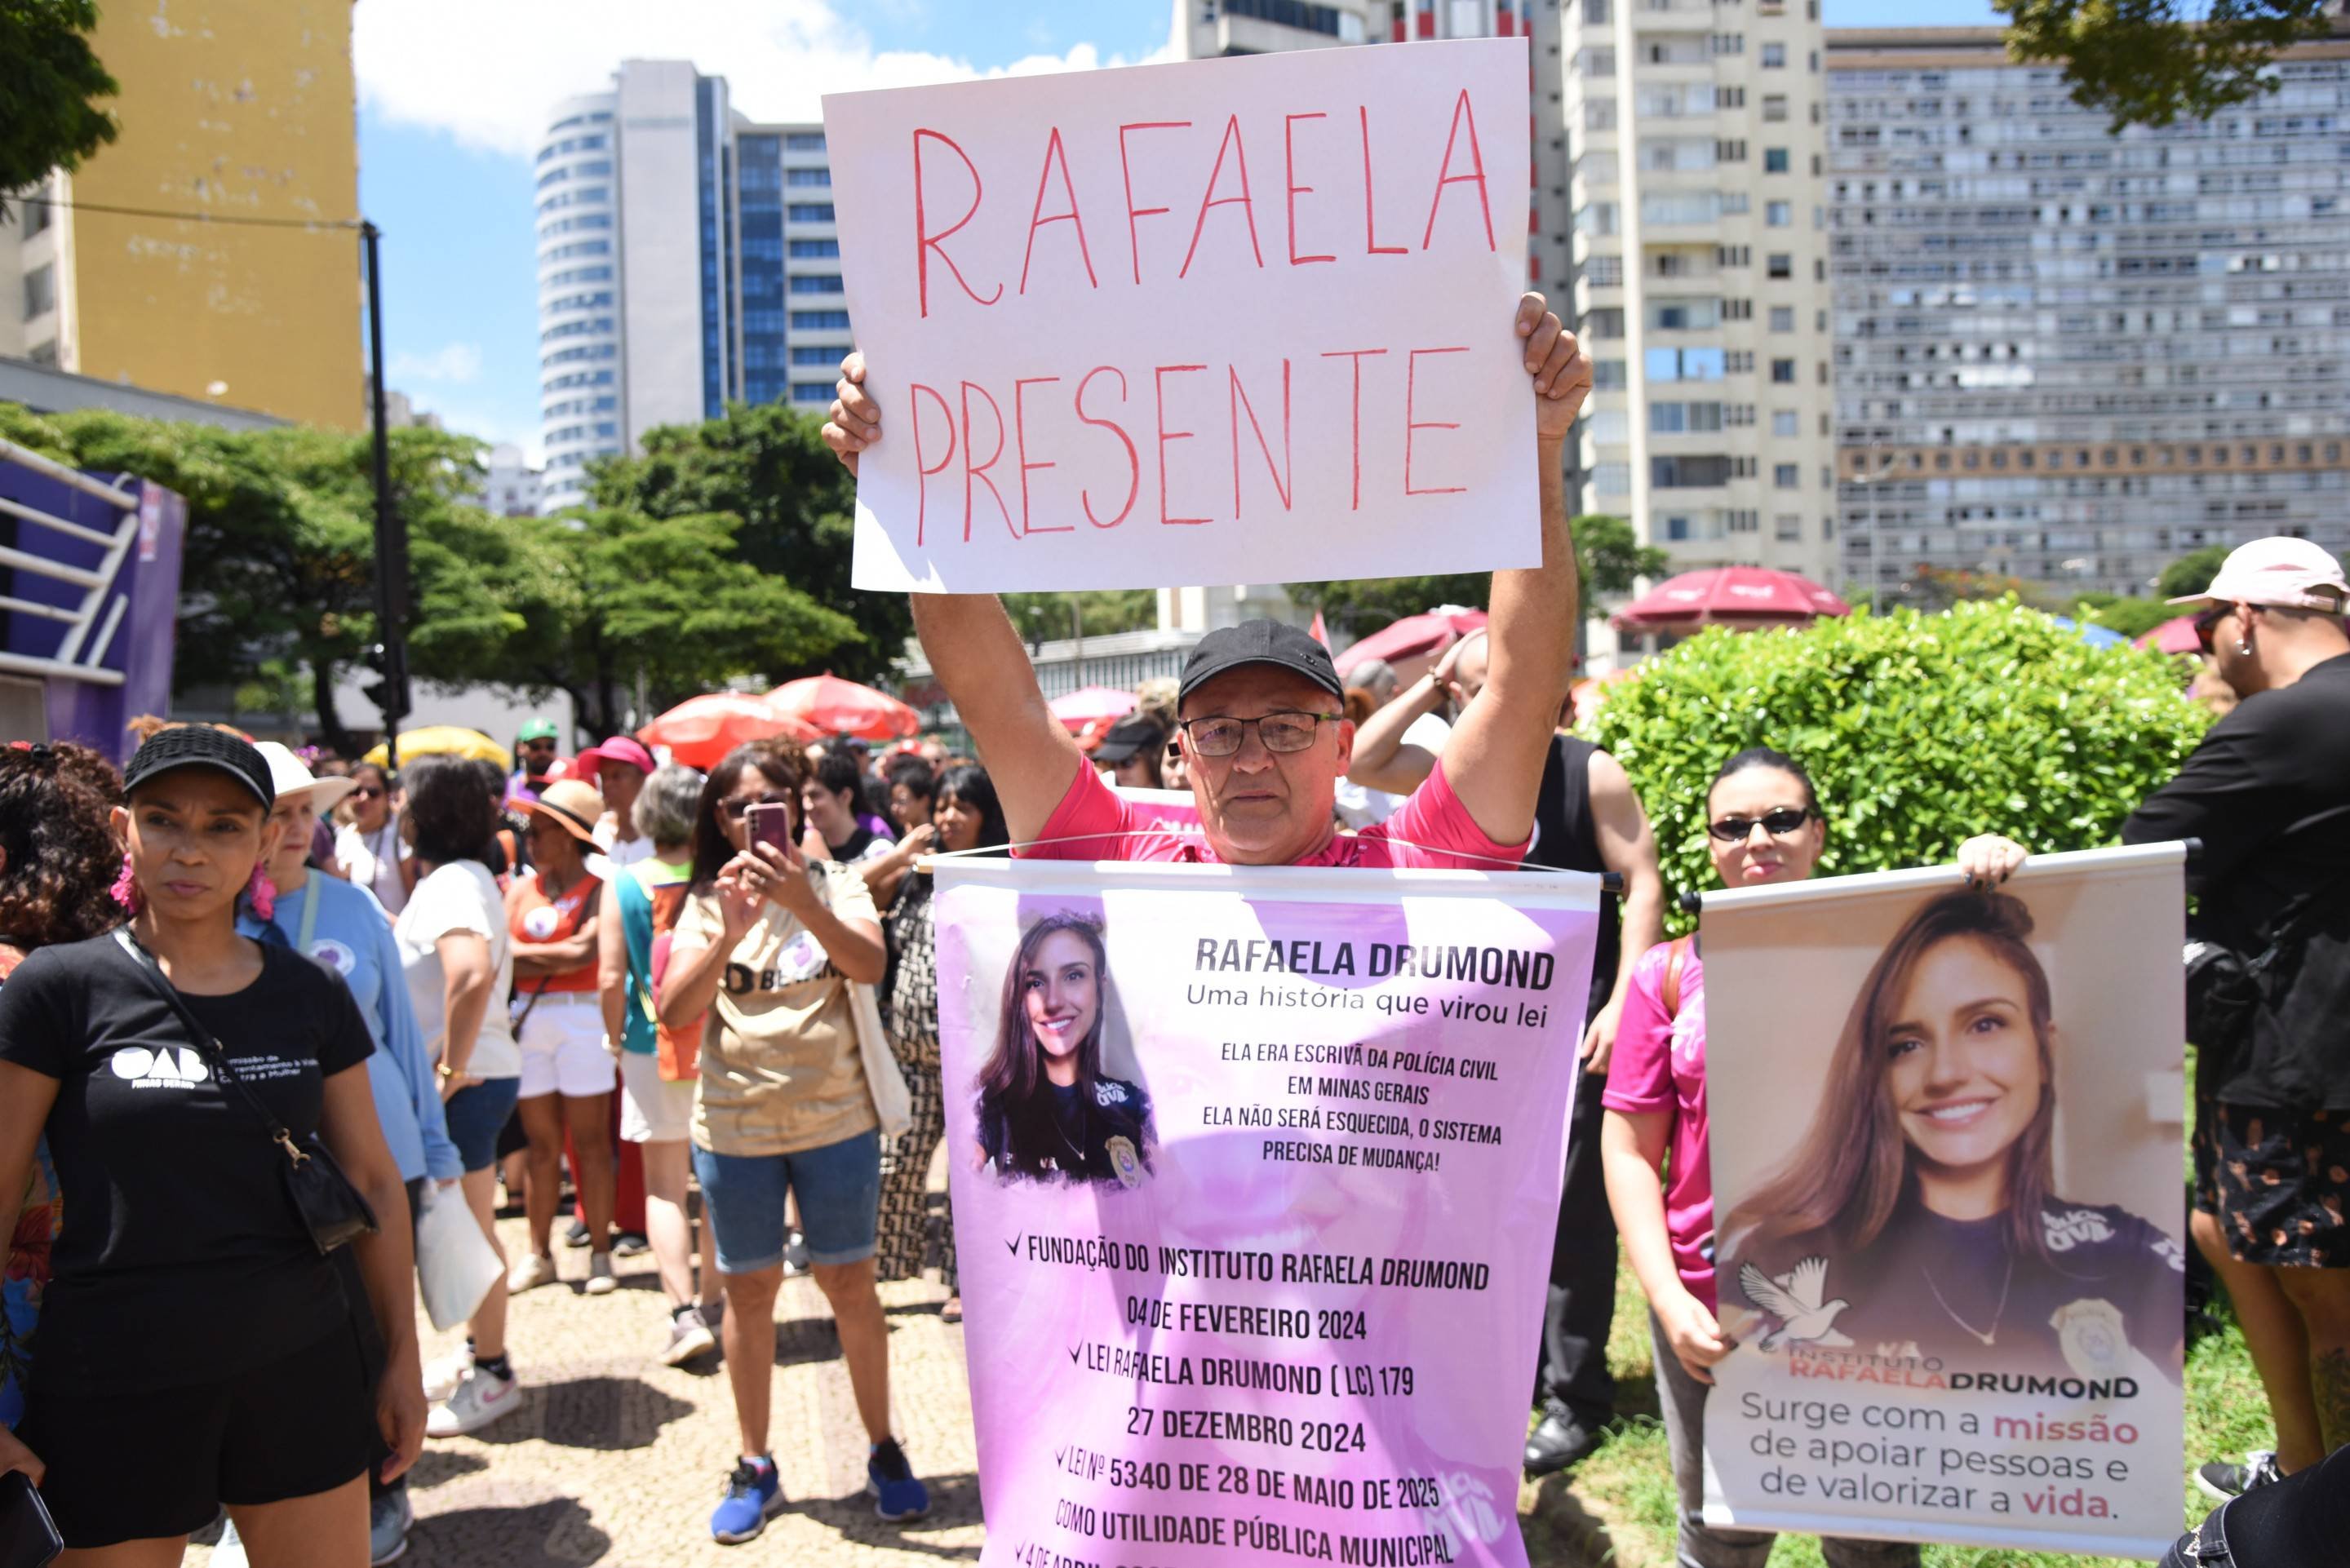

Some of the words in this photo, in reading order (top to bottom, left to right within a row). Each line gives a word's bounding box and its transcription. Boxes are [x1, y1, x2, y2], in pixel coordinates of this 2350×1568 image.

[913, 88, 1496, 318] RAFAELA
[911, 346, 1470, 547] PRESENTE
[1195, 937, 1356, 977] RAFAELA
[1368, 943, 1555, 991] DRUMOND
[1186, 984, 1248, 1006] Uma
[1259, 986, 1365, 1009] história
[1376, 993, 1430, 1014] que
[1440, 995, 1507, 1025] virou
[1518, 1003, 1548, 1028] lei
[111, 1047, 209, 1083] OAB
[1222, 1043, 1252, 1061] ELA
[1257, 1043, 1288, 1061] ERA
[1294, 1043, 1363, 1066] ESCRIVÃ
[1368, 1048, 1388, 1069] DA
[1392, 1051, 1455, 1077] POLÍCIA
[1459, 1059, 1499, 1081] CIVIL
[1288, 1076, 1313, 1095] EM
[1318, 1077, 1370, 1100] MINAS
[1375, 1082, 1430, 1105] GERAIS
[1203, 1106, 1233, 1125] ELA
[1239, 1104, 1272, 1127] NÃO
[1278, 1105, 1321, 1129] SERÁ
[1327, 1111, 1414, 1140] ESQUECIDA,
[1419, 1118, 1429, 1137] O
[1433, 1120, 1501, 1145] SISTEMA
[1263, 1141, 1333, 1164] PRECISA
[1338, 1145, 1359, 1165] DE
[1362, 1147, 1440, 1174] MUDANÇA!
[1028, 1235, 1120, 1271] FUNDAÇÃO
[1125, 1243, 1149, 1272] DO
[1159, 1247, 1273, 1282] INSTITUTO
[1281, 1253, 1373, 1285] RAFAELA
[1380, 1258, 1489, 1290] DRUMOND
[1128, 1296, 1147, 1326] 04
[1150, 1299, 1173, 1330] DE
[1180, 1304, 1310, 1339] FEVEREIRO
[1319, 1309, 1367, 1340] 2024
[1088, 1343, 1110, 1373] LEI
[1114, 1347, 1194, 1385] RAFAELA
[1202, 1358, 1321, 1395] DRUMOND
[1379, 1366, 1414, 1396] 179
[1789, 1348, 1944, 1372] INSTITUTO
[1127, 1406, 1154, 1436] 27
[1163, 1410, 1292, 1446] DEZEMBRO
[1301, 1421, 1366, 1452] 2024
[1741, 1392, 1851, 1429] Surge
[1862, 1404, 1945, 1432] com
[1960, 1412, 1980, 1434] a
[1994, 1412, 2139, 1444] missão
[1068, 1445, 1088, 1477] LEI
[1111, 1458, 1171, 1490] 5340
[1179, 1464, 1210, 1491] DE
[1217, 1465, 1249, 1495] 28
[1257, 1468, 1286, 1499] DE
[1293, 1473, 1354, 1509] MAIO
[1363, 1479, 1392, 1510] DE
[1397, 1477, 1439, 1508] 2025
[1749, 1430, 1797, 1456] de
[1808, 1438, 1927, 1467] apoiar
[1940, 1446, 2094, 1480] pessoas
[2106, 1459, 2129, 1482] e
[1760, 1468, 1807, 1495] de
[1816, 1472, 1976, 1510] valorizar
[1990, 1491, 2011, 1513] a
[2023, 1486, 2119, 1520] vida.
[1056, 1499, 1095, 1536] COMO
[1102, 1511, 1226, 1545] UTILIDADE
[1234, 1515, 1332, 1561] PÚBLICA
[1340, 1533, 1454, 1568] MUNICIPAL
